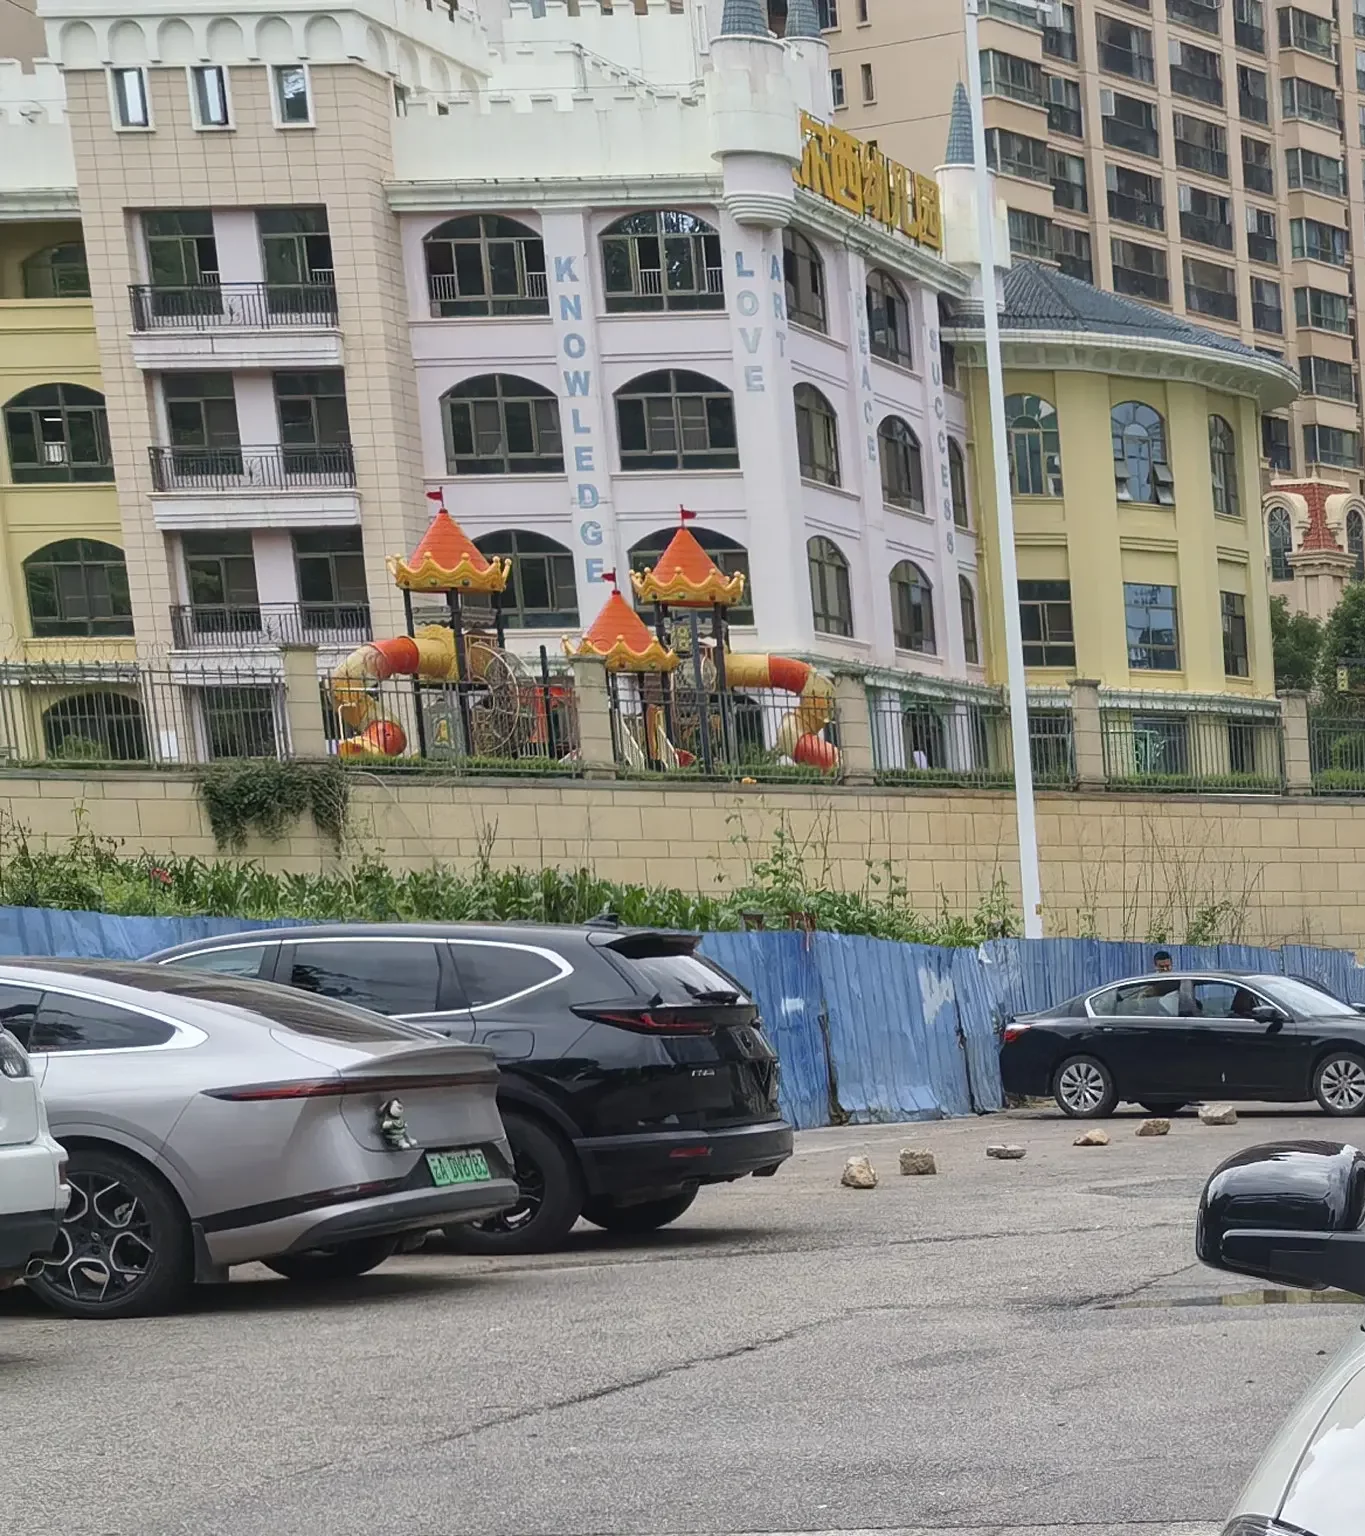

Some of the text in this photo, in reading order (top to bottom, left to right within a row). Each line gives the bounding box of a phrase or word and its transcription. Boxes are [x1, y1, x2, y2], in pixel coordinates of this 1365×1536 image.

[735, 251, 765, 392] LOVE
[770, 254, 787, 358] ART
[856, 291, 877, 462] PEACE
[554, 255, 605, 583] KNOWLEDGE
[929, 328, 954, 554] SUCCESS
